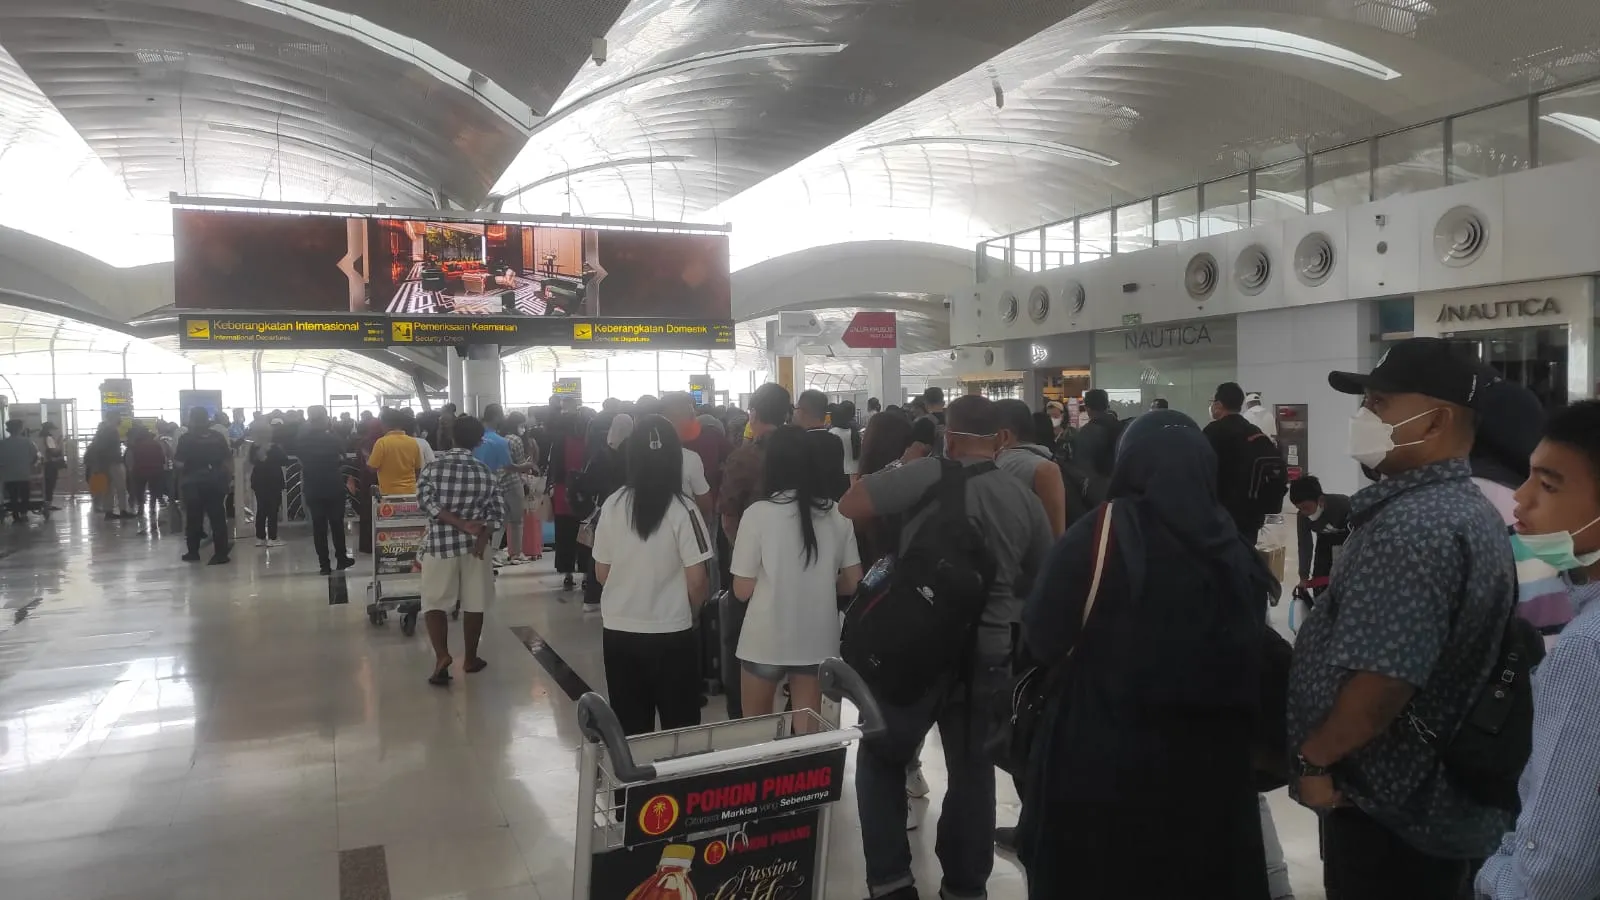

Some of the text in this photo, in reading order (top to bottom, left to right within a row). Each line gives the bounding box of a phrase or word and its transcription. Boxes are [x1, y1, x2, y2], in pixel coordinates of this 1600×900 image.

[213, 320, 360, 332] Keberangkatan Internasional
[414, 322, 518, 332] Pemeriksaan Keamanan
[594, 324, 664, 335] Keberangkatan
[1124, 323, 1212, 350] NAUTICA
[383, 544, 413, 555] Super
[685, 767, 832, 814] POHON PINANG
[721, 806, 758, 820] Markisa
[780, 790, 829, 807] Sebenarnya
[738, 858, 798, 887] Passion
